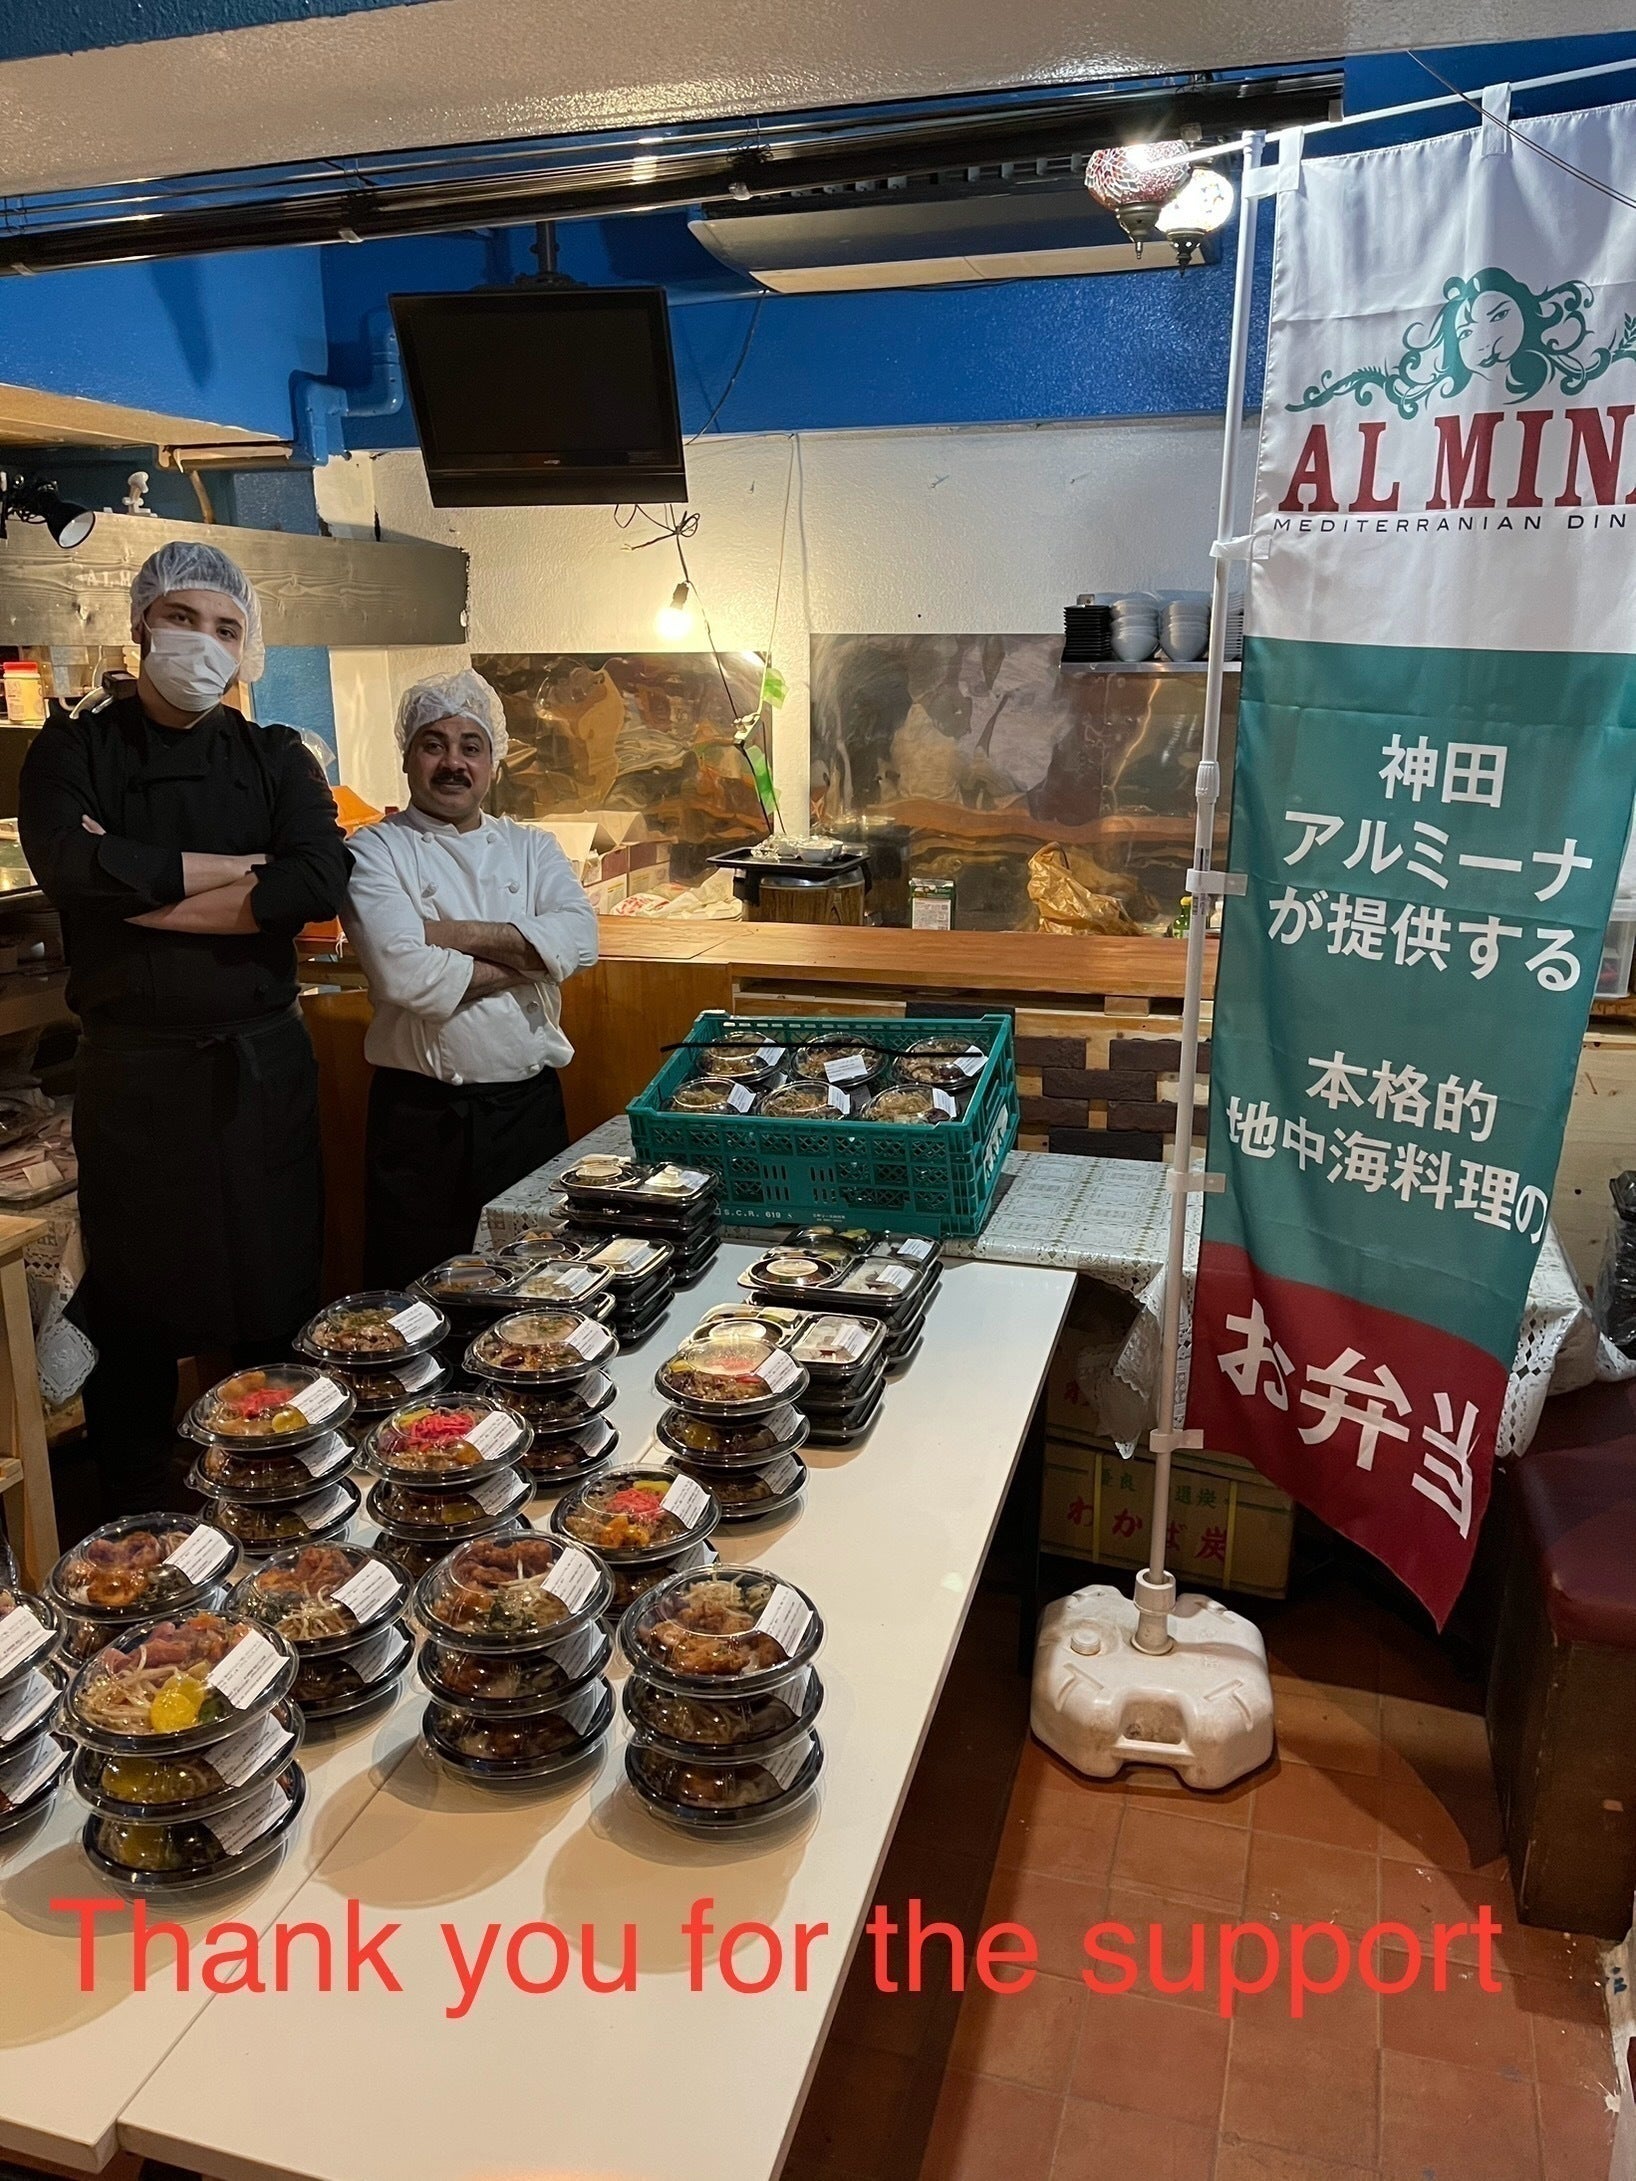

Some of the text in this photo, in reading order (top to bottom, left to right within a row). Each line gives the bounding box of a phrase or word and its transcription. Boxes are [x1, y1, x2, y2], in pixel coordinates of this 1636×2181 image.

[1278, 408, 1636, 511] AL MIN
[1273, 516, 1541, 532] MEDITERRANIAN
[1378, 733, 1508, 808] 神田
[1283, 810, 1593, 903] アルミーナ
[1268, 886, 1581, 992] が提供する
[1305, 1050, 1498, 1142] 本格的
[1226, 1096, 1549, 1244] 地中海料理の
[1217, 1298, 1480, 1540] お弁当
